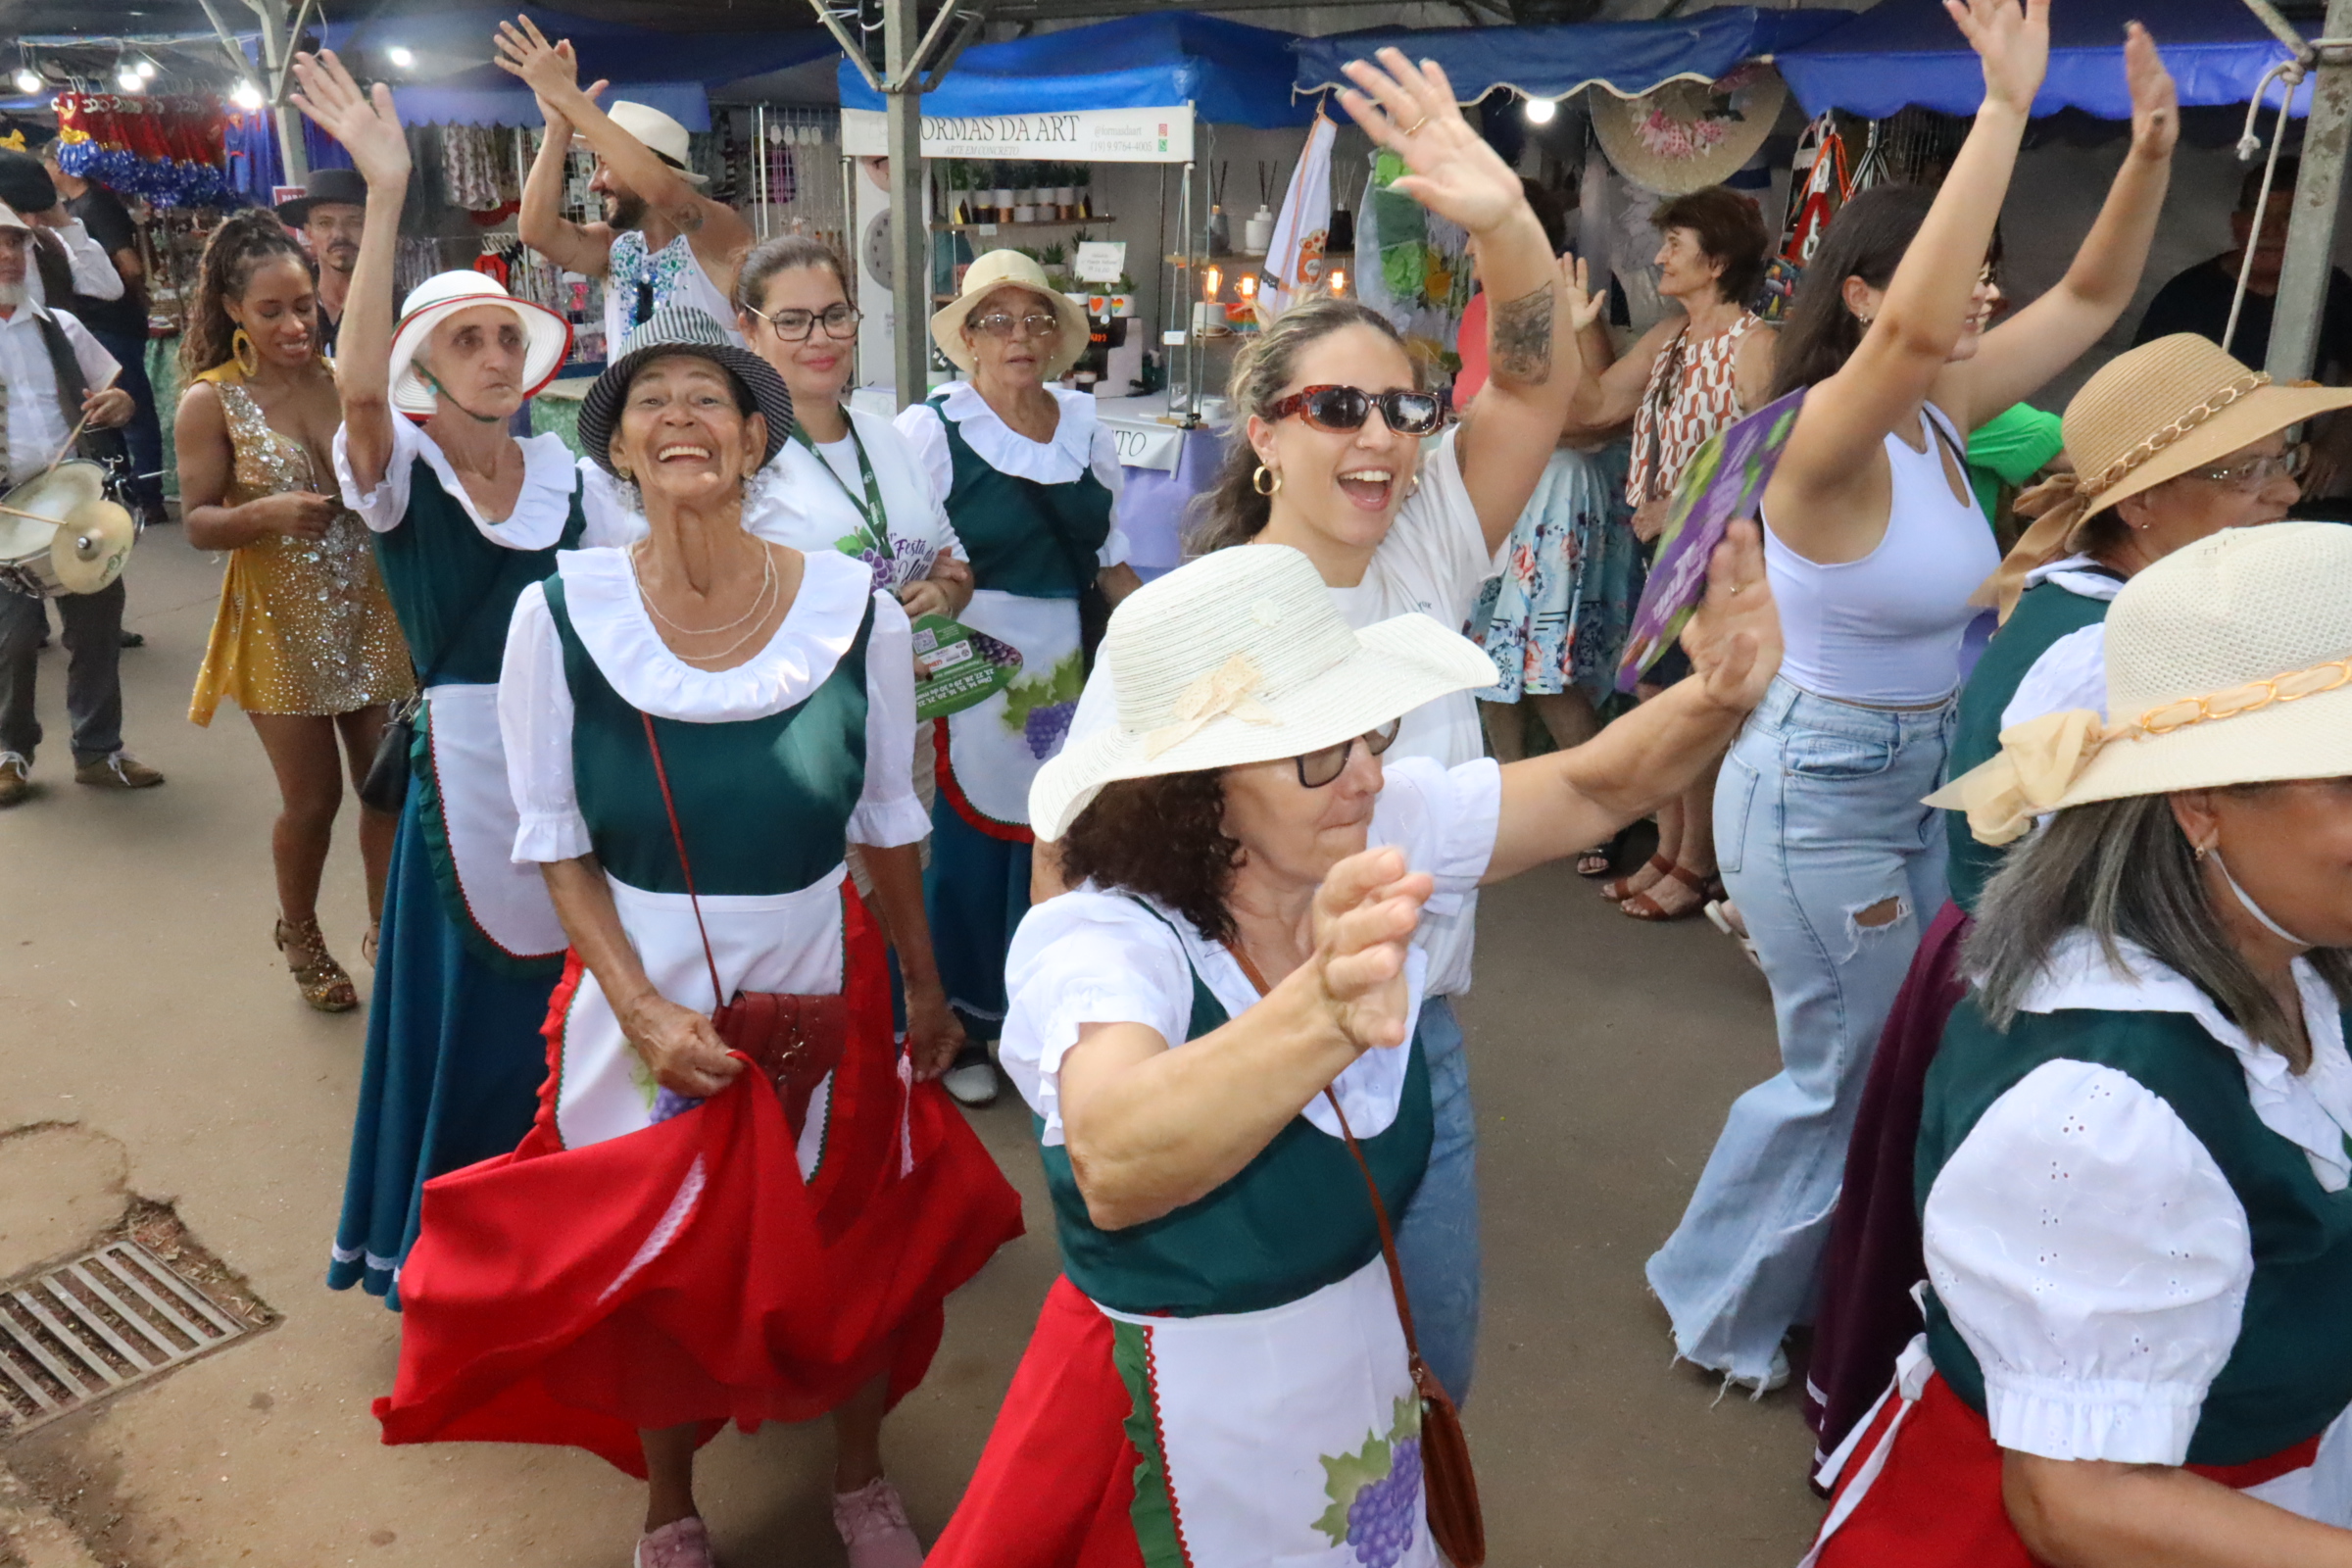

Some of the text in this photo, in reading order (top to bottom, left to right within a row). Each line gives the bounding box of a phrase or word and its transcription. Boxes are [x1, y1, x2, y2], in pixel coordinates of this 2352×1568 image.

[919, 115, 1080, 142] ORMAS DA ART
[945, 146, 1019, 156] ARTE EM CONCRETO
[1090, 141, 1105, 152] (19)
[894, 538, 926, 561] Festa
